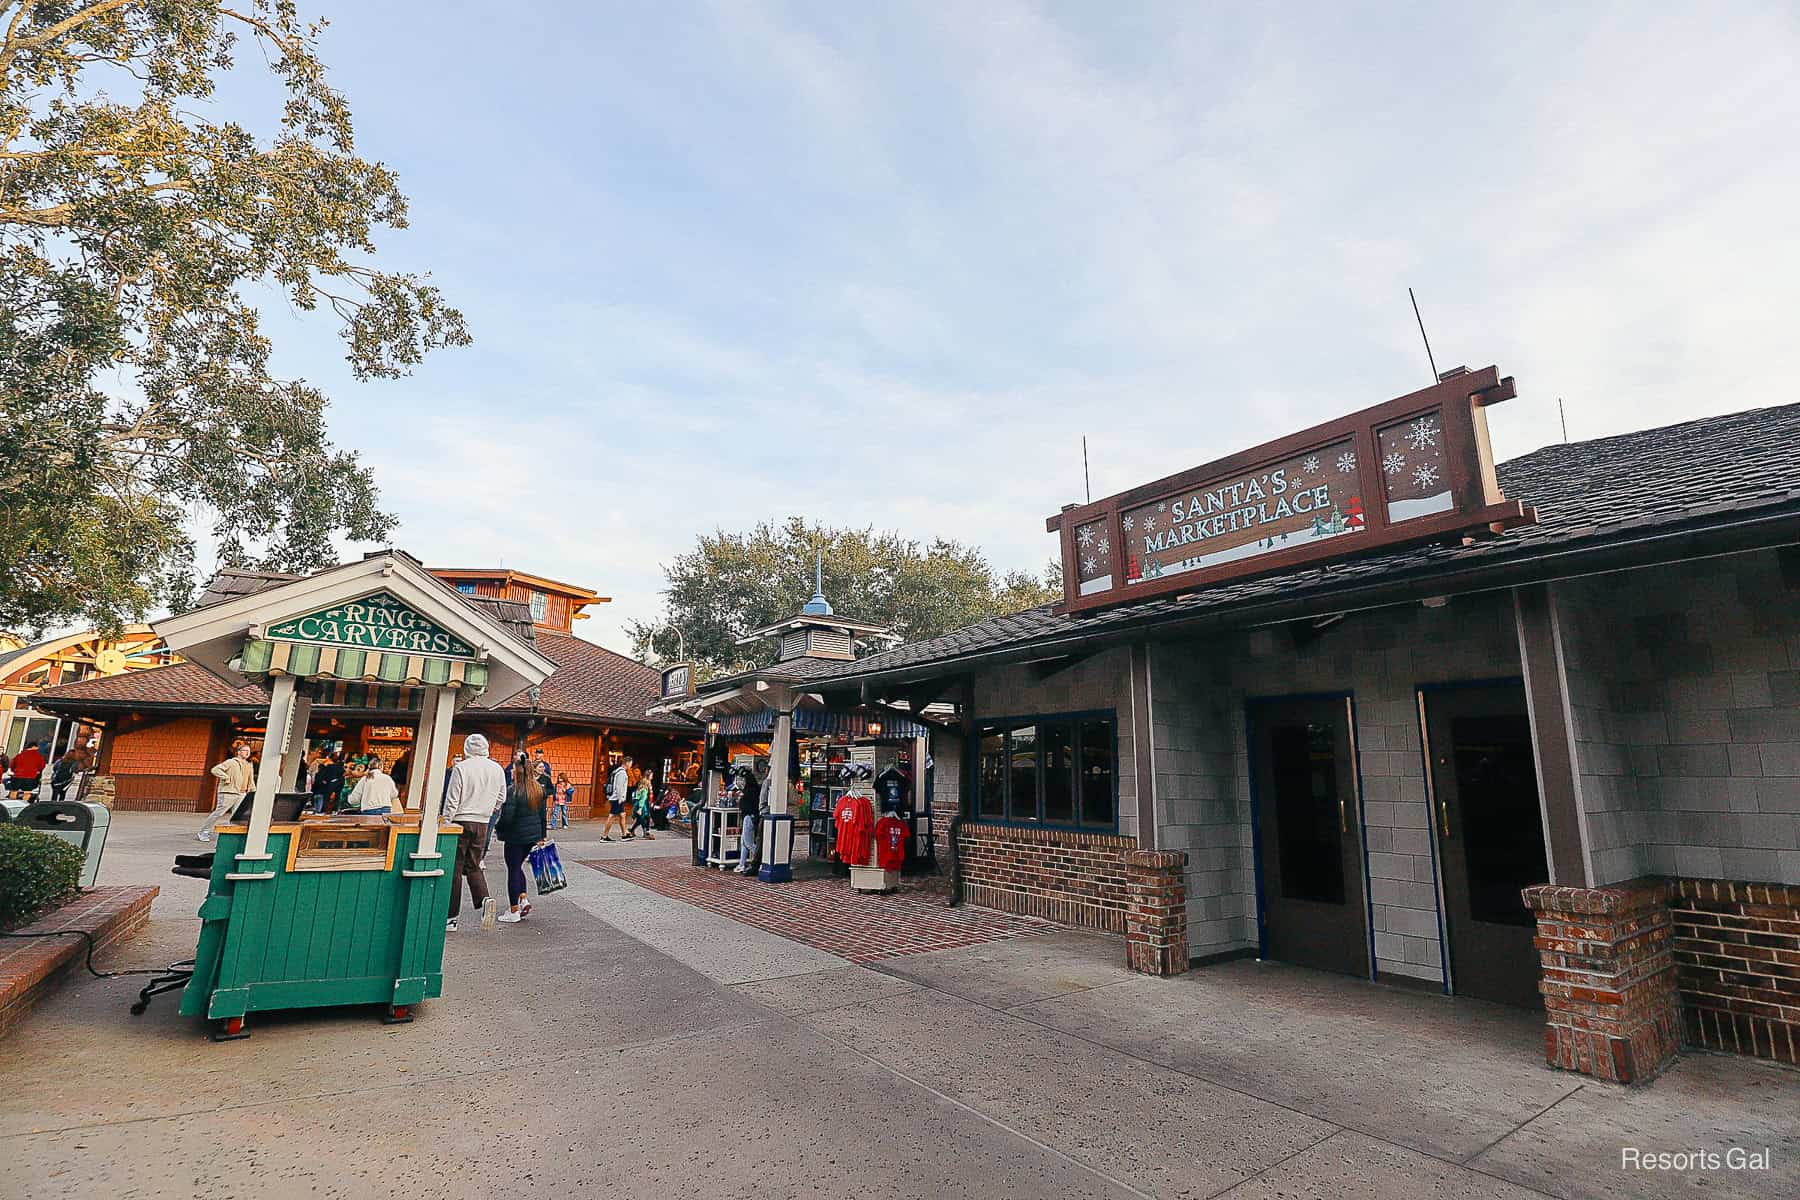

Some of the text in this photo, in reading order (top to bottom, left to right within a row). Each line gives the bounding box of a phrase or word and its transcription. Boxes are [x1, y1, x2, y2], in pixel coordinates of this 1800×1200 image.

[1143, 484, 1331, 555] MARKETPLACE
[1171, 469, 1288, 525] SANTA'S
[298, 617, 450, 653] CARVERS
[343, 604, 416, 629] RING
